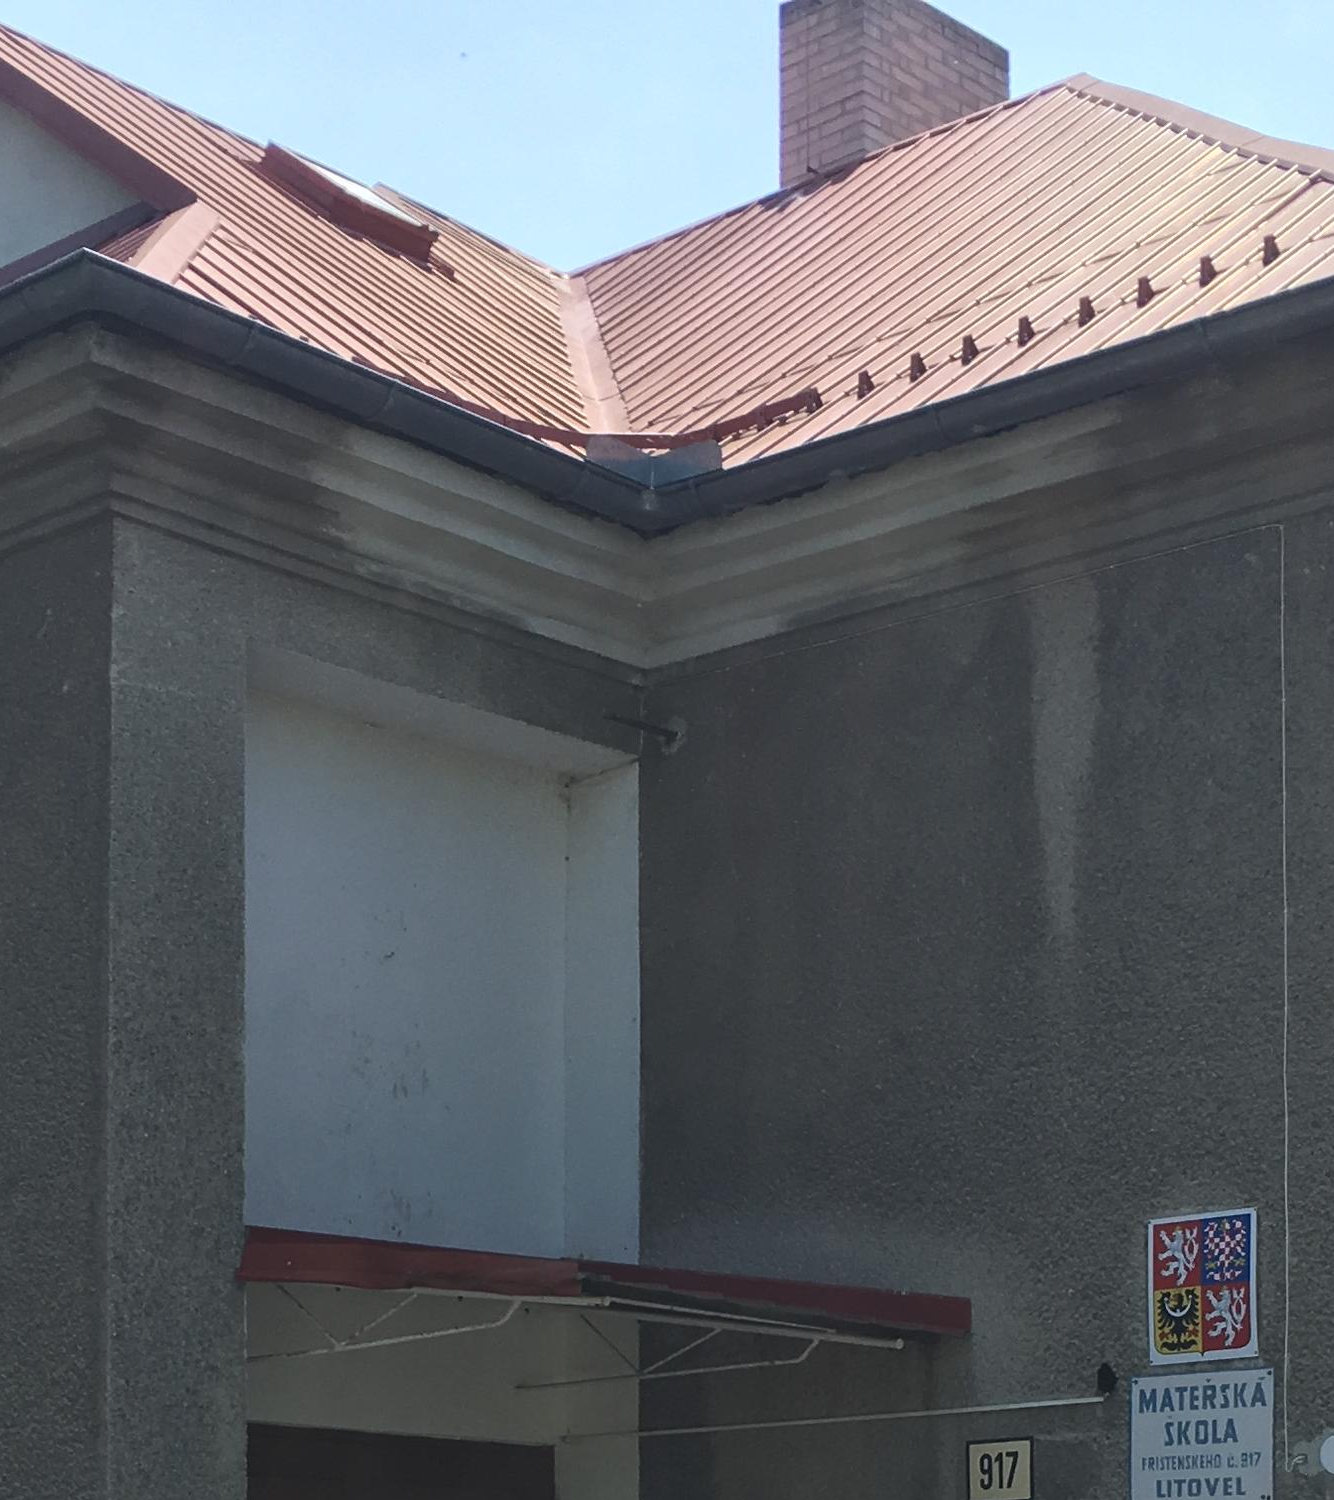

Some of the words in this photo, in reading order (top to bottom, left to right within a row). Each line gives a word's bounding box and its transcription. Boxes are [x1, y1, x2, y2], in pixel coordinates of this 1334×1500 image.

[1139, 1377, 1267, 1413] MATEŘSKÁ
[1164, 1417, 1238, 1446] ŠKOLA
[979, 1451, 1018, 1490] 917
[1156, 1477, 1246, 1498] LITOVEL
